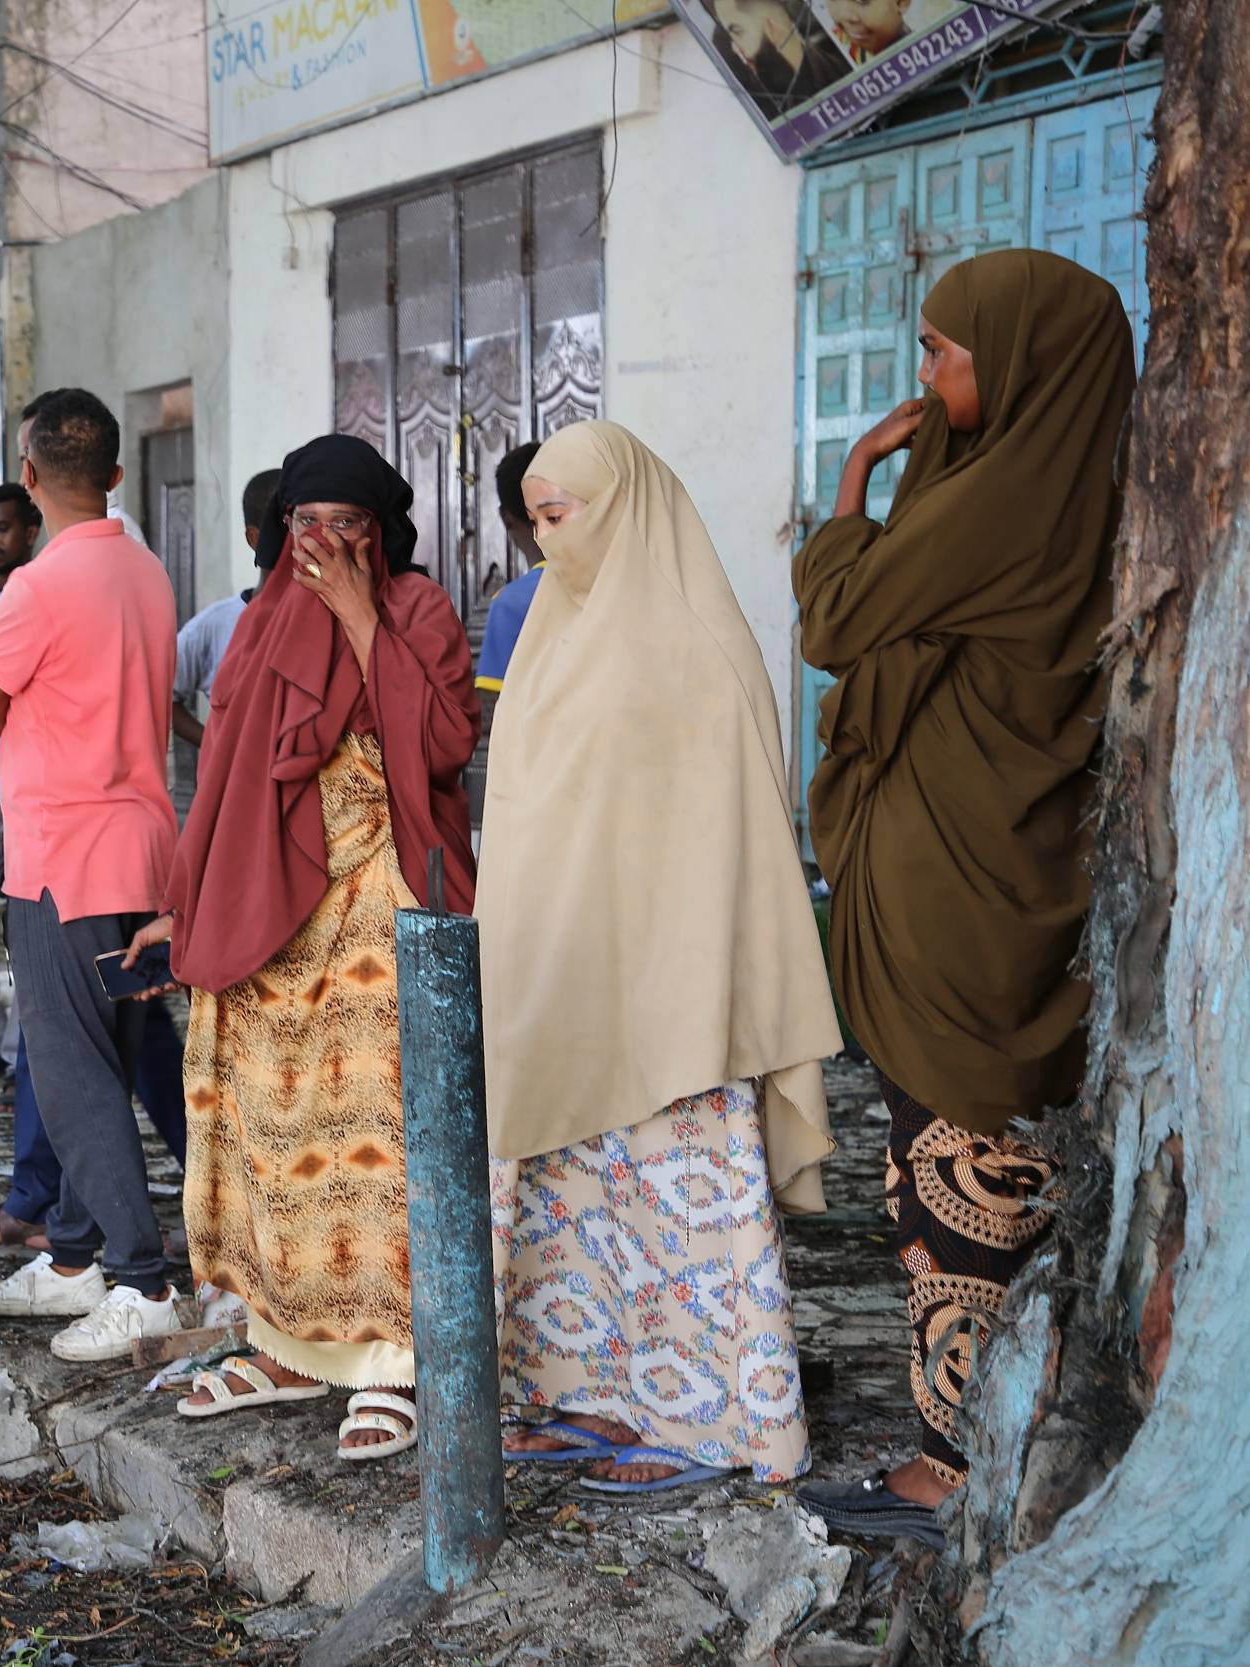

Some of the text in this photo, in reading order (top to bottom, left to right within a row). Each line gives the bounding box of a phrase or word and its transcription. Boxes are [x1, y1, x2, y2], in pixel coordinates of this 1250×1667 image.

[212, 21, 266, 82] STAR
[810, 95, 856, 130] TEL:
[852, 66, 902, 105] 0615
[900, 17, 975, 75] 942243
